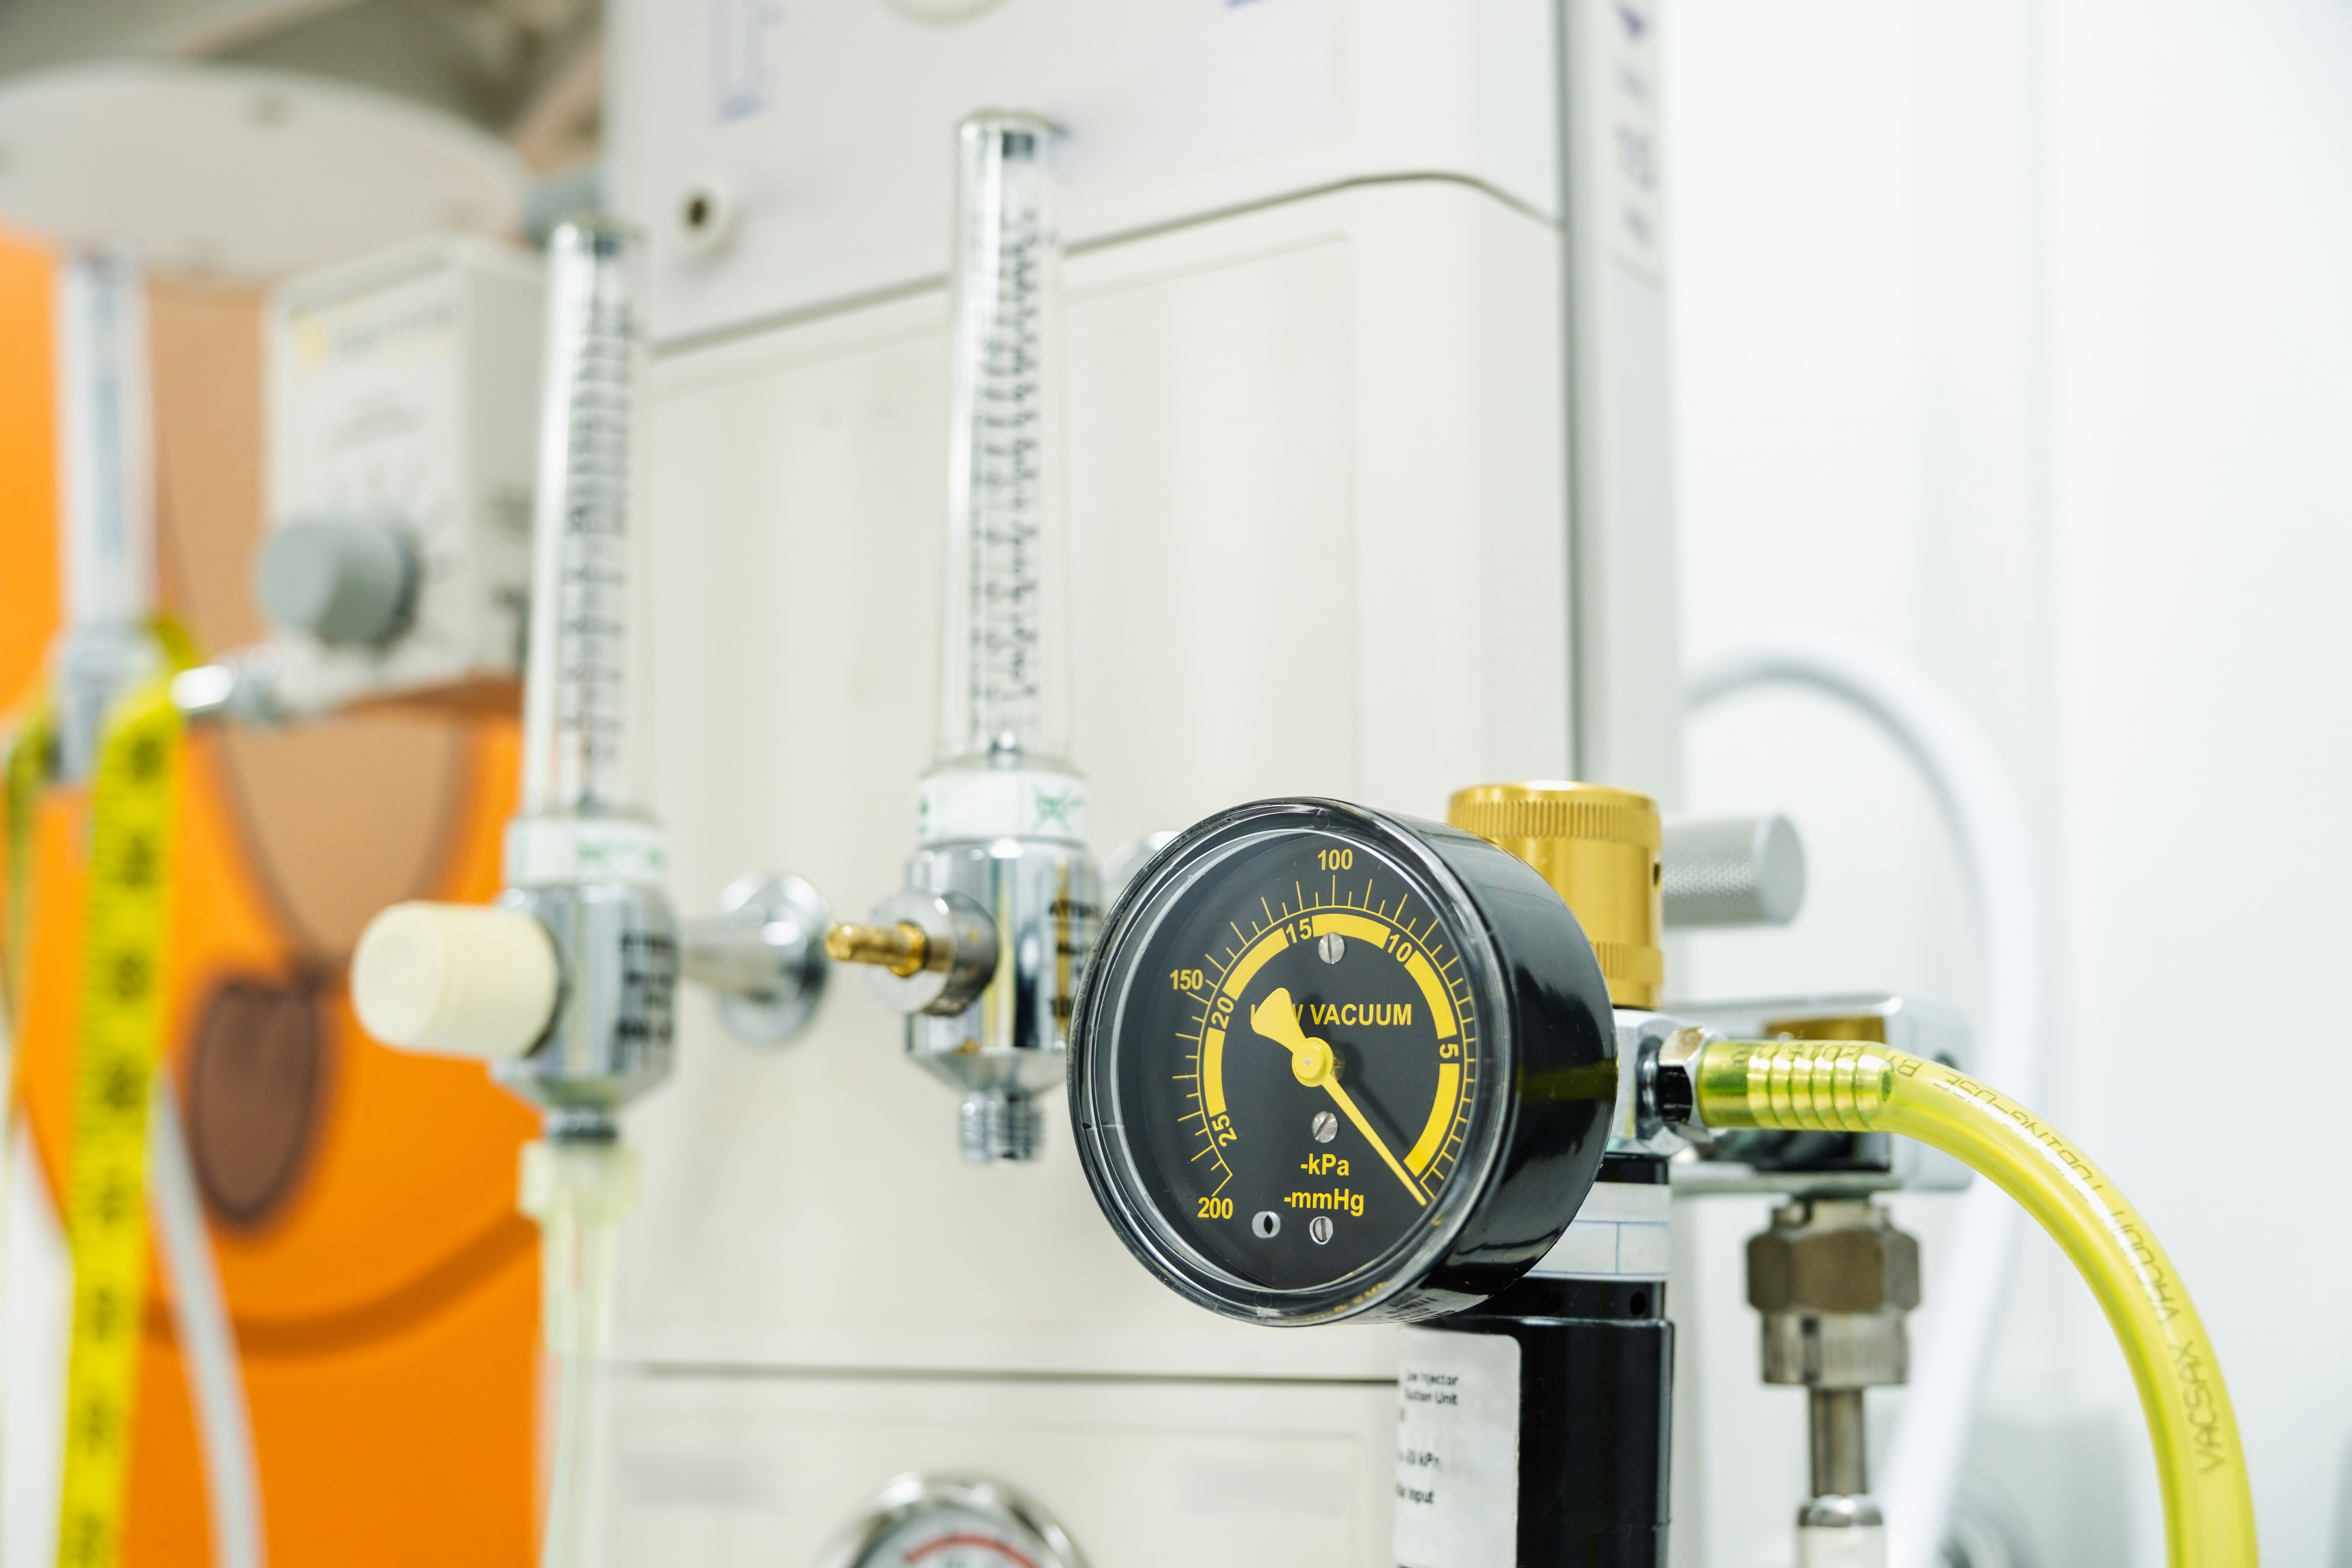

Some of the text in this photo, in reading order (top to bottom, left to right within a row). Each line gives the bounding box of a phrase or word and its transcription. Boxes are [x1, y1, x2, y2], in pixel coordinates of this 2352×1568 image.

[1318, 848, 1353, 870] 100
[1286, 917, 1312, 943] 15
[1387, 934, 1412, 962] 10
[1170, 969, 1203, 990] 150
[1211, 997, 1234, 1029] 20
[1310, 1003, 1412, 1026] VACUUM
[1439, 1043, 1459, 1059] 5
[1883, 1055, 1923, 1077] BY
[1211, 1115, 1237, 1147] 25
[1301, 1153, 1350, 1176] -kPa
[1197, 1197, 1233, 1219] 200
[1284, 1188, 1364, 1217] -mmHg
[1435, 1391, 1458, 1404] Unit
[2167, 1340, 2226, 1473] VACSAX
